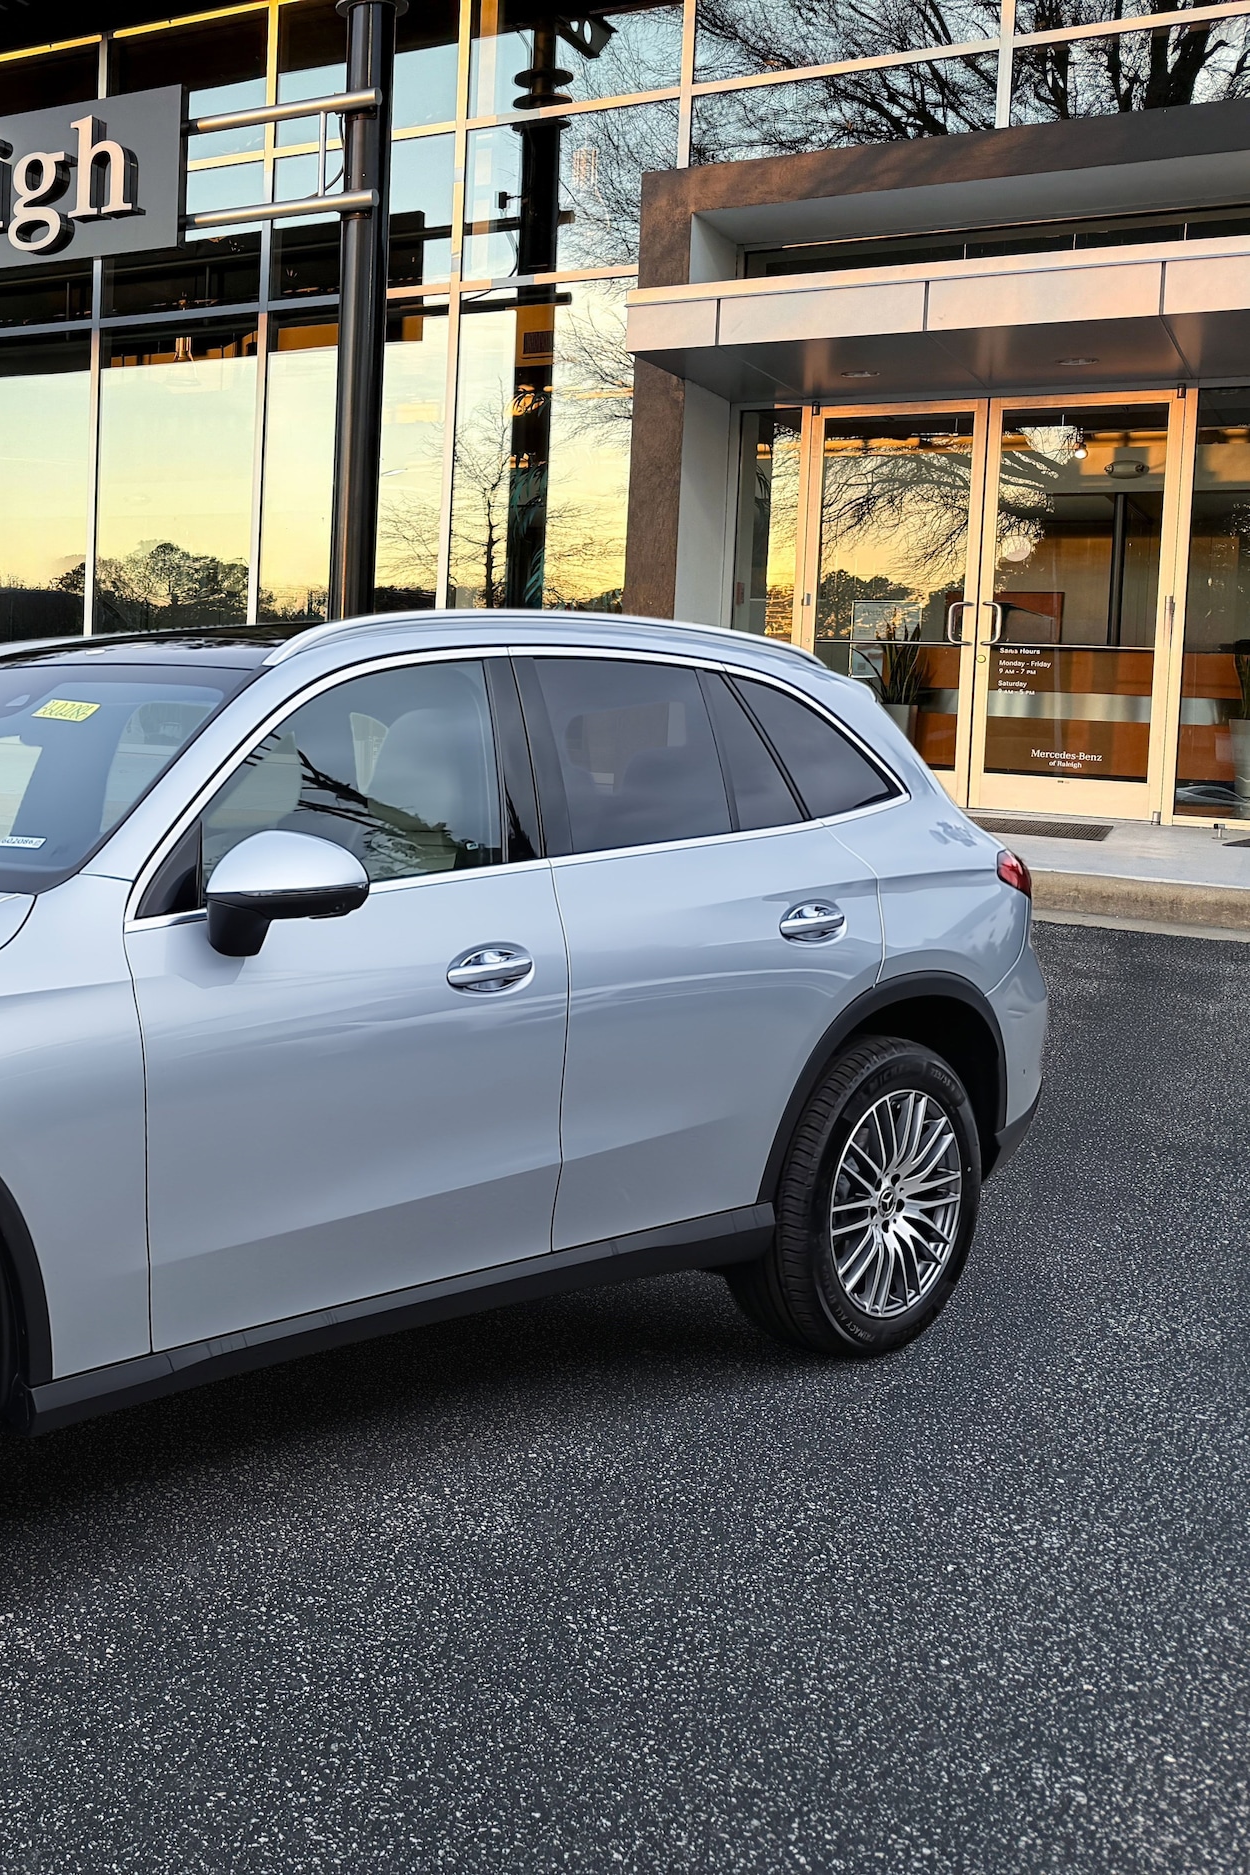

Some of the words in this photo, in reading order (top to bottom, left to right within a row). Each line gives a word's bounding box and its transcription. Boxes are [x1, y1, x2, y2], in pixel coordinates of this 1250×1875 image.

[1019, 647, 1041, 655] Hours
[1030, 661, 1052, 669] Friday
[997, 680, 1027, 688] Saturday
[1031, 749, 1103, 762] Mercedes-Benz
[1057, 761, 1082, 769] Raleigh
